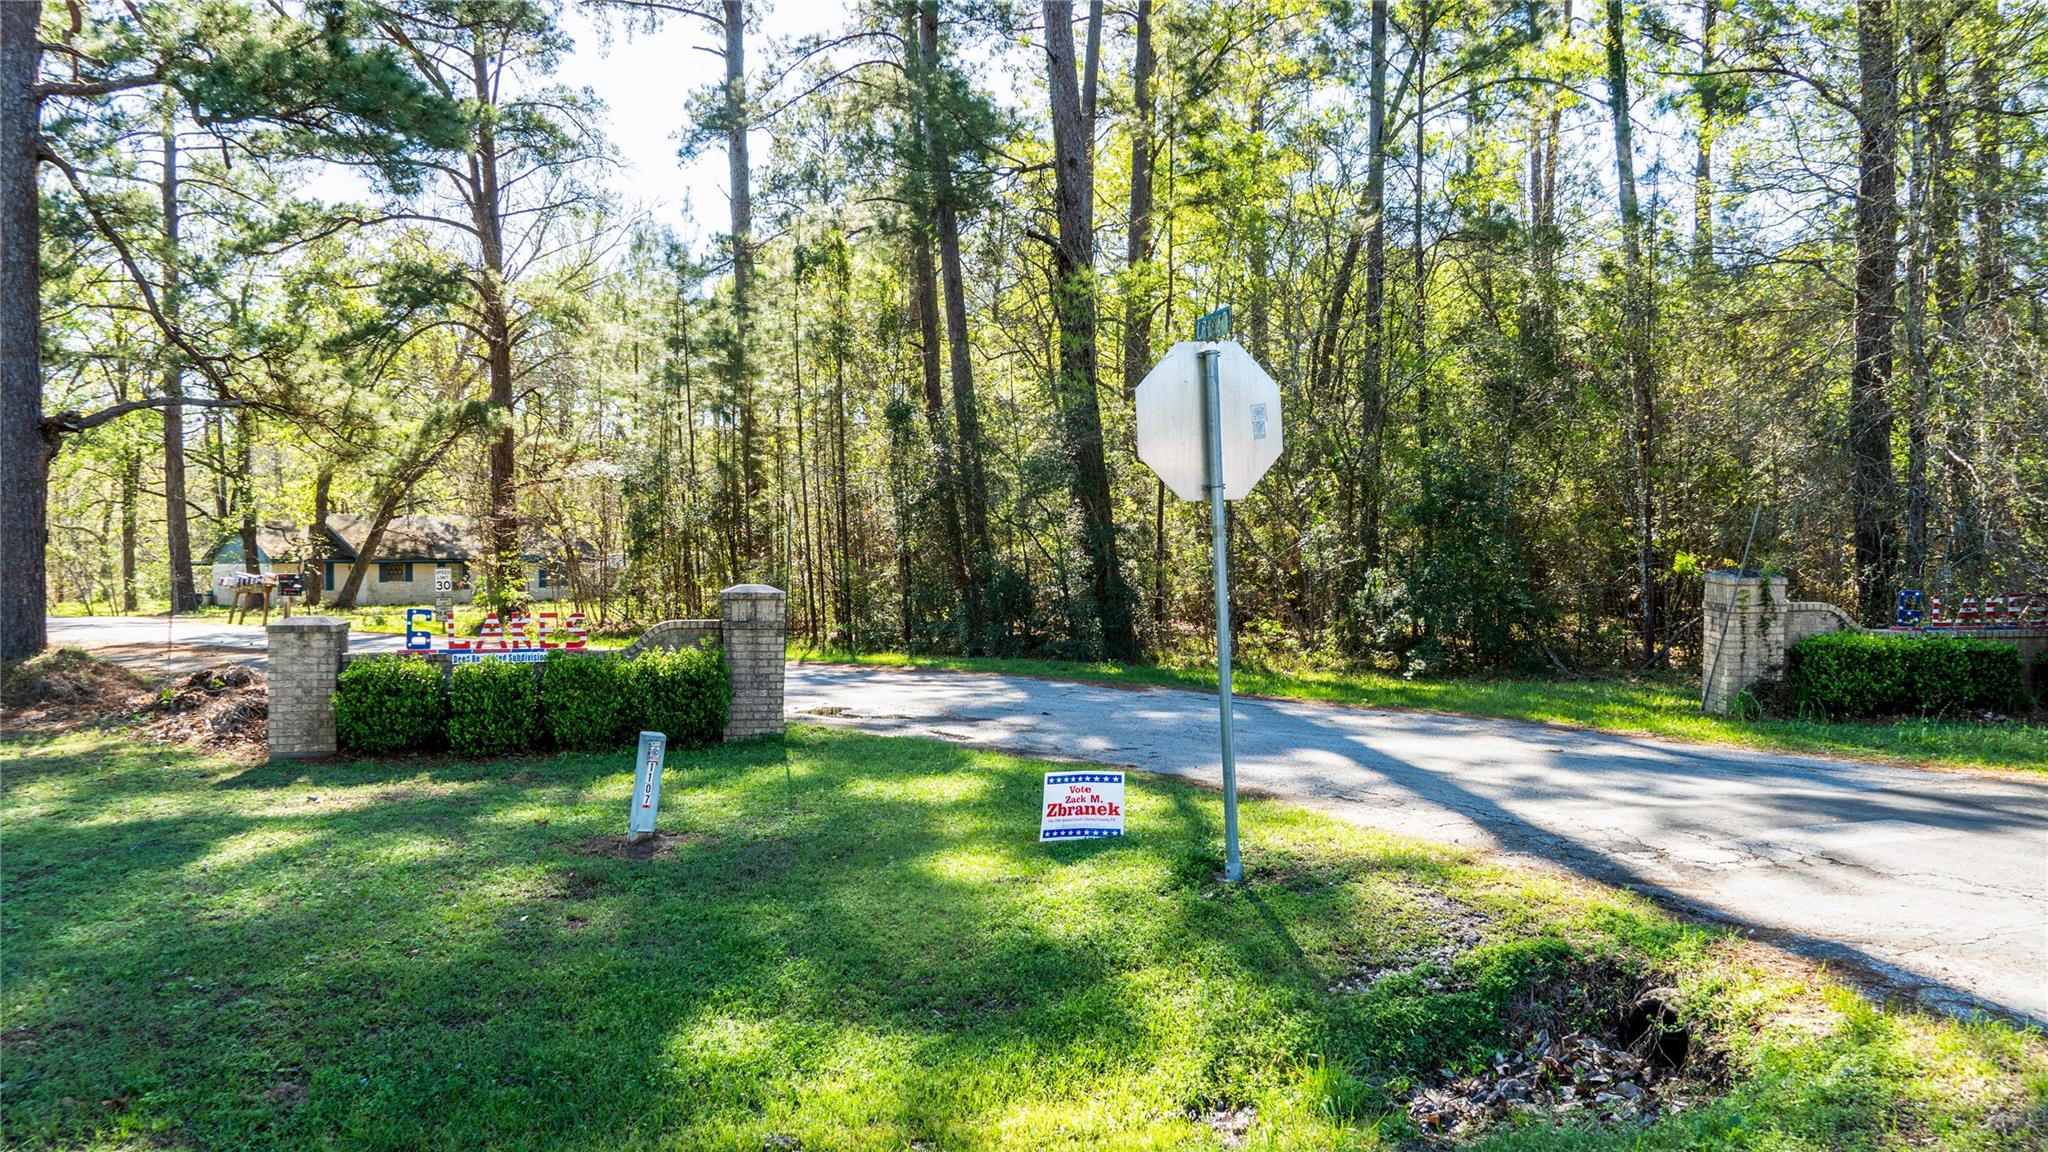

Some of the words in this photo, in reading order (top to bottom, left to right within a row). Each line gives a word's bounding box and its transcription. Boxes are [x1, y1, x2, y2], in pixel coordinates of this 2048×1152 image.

[436, 581, 451, 590] 30
[407, 609, 432, 649] 6
[447, 612, 588, 650] LAKES
[509, 653, 548, 663] Subdivisio
[645, 762, 654, 804] 1107
[1069, 785, 1092, 794] Vote
[1065, 795, 1086, 804] Zack
[1090, 794, 1104, 803] M.
[1046, 802, 1120, 817] Zbranek
